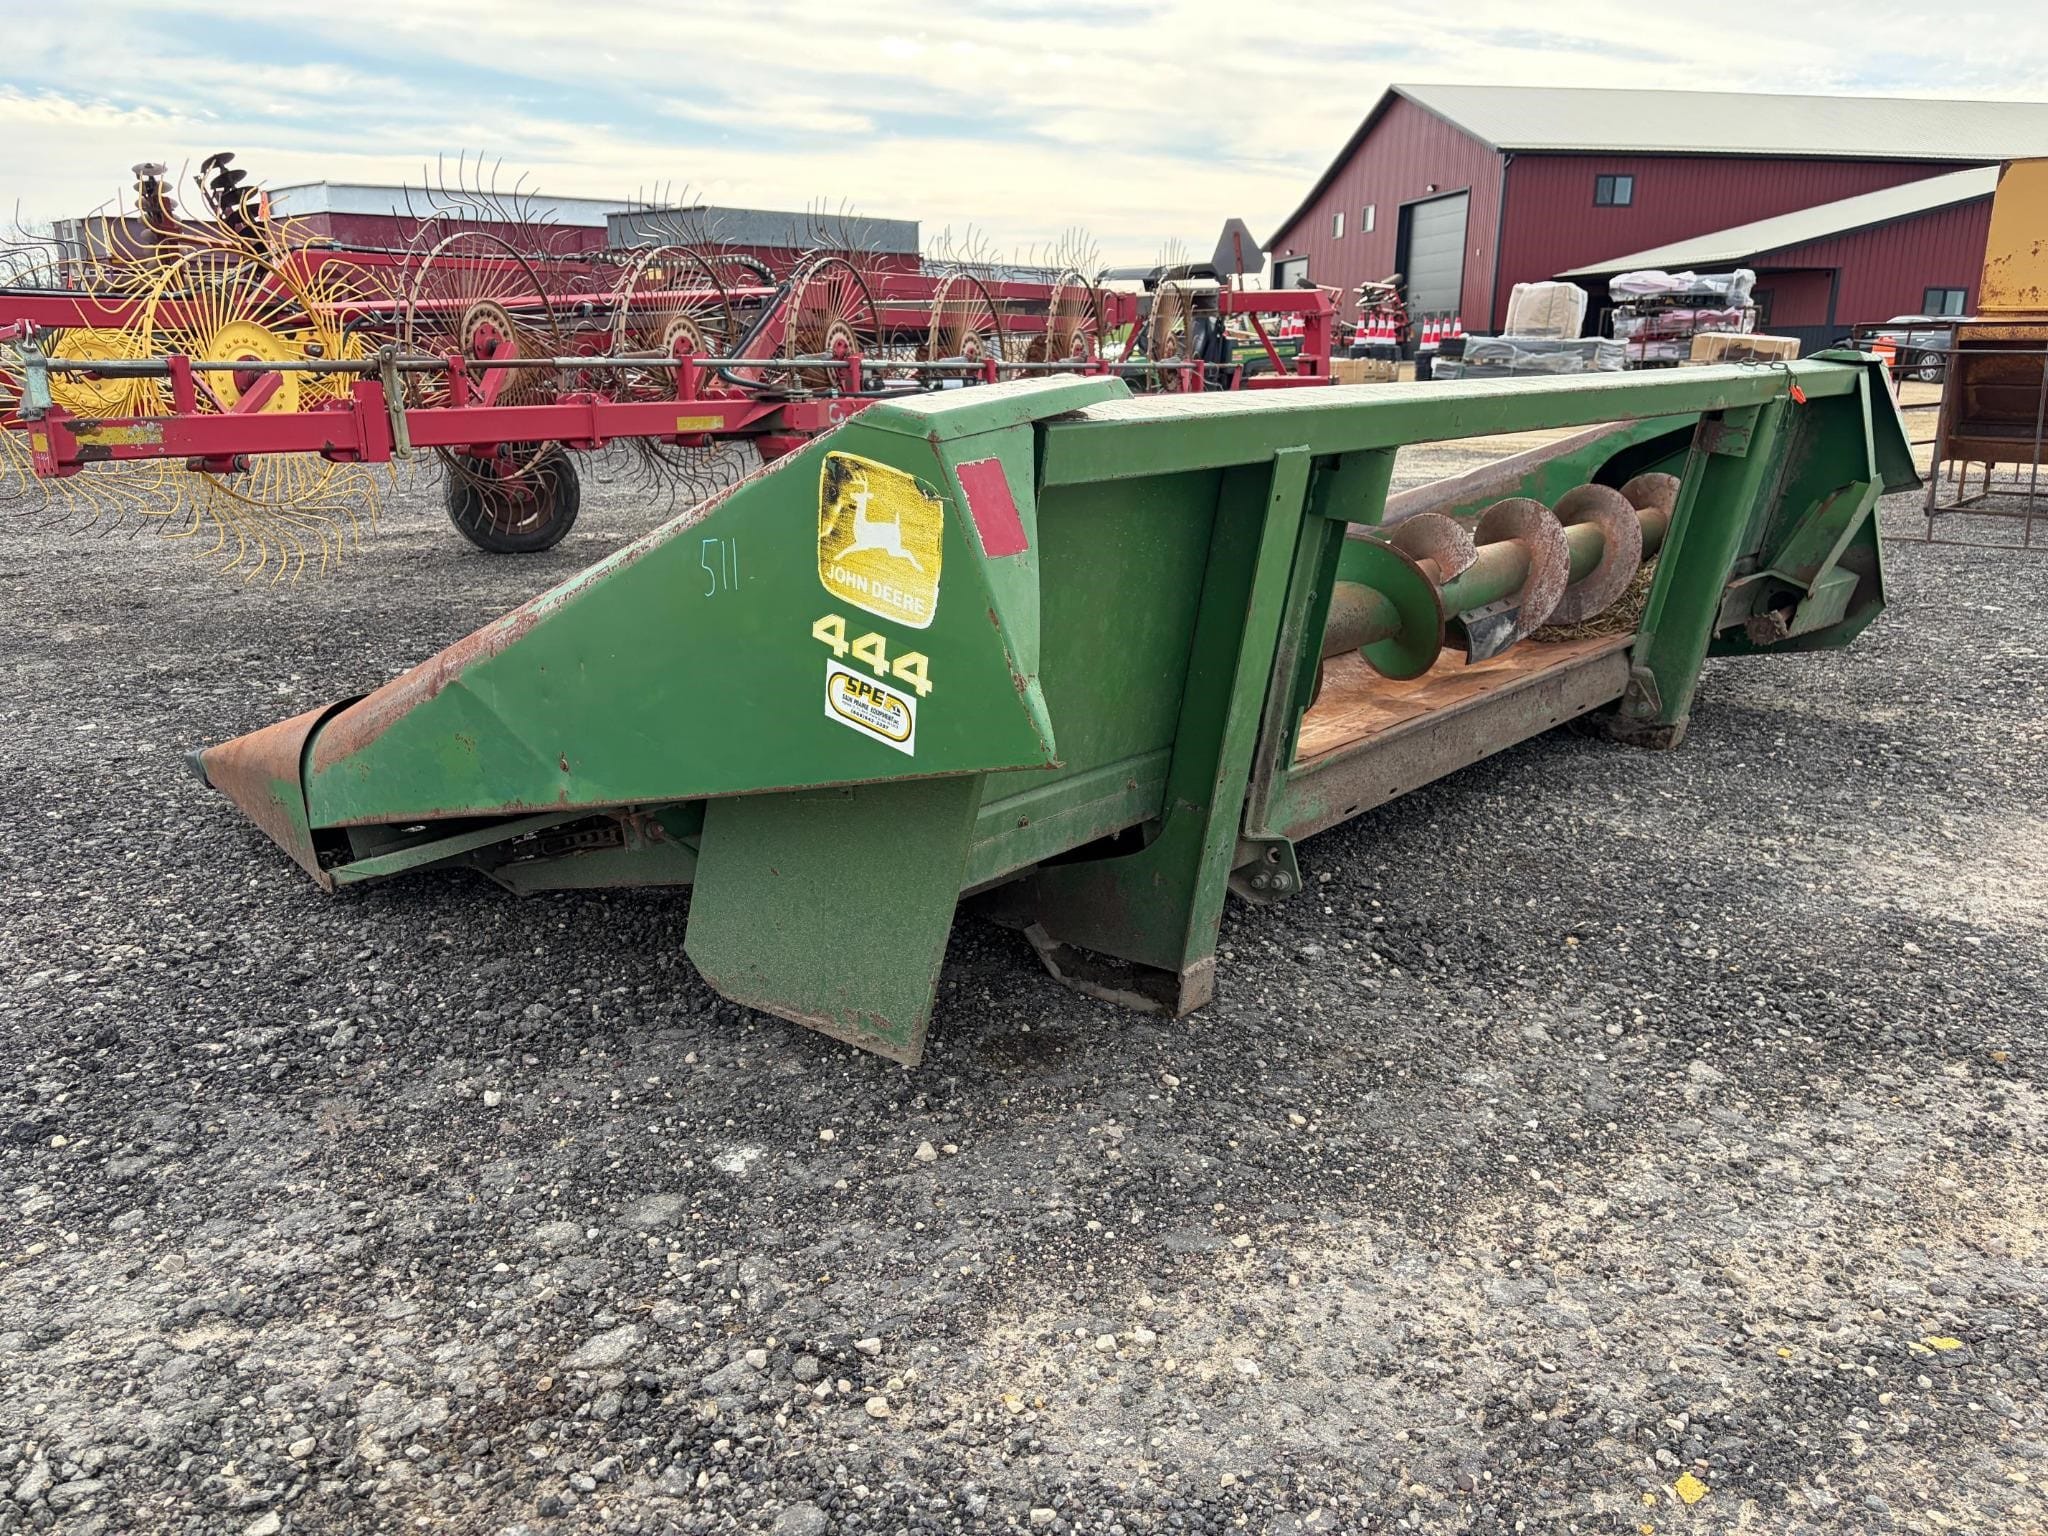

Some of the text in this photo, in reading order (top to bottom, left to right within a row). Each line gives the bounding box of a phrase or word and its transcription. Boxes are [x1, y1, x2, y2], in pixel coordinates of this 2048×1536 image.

[701, 538, 738, 598] 511
[827, 567, 926, 613] JOHN DEERE
[812, 613, 932, 697] 444
